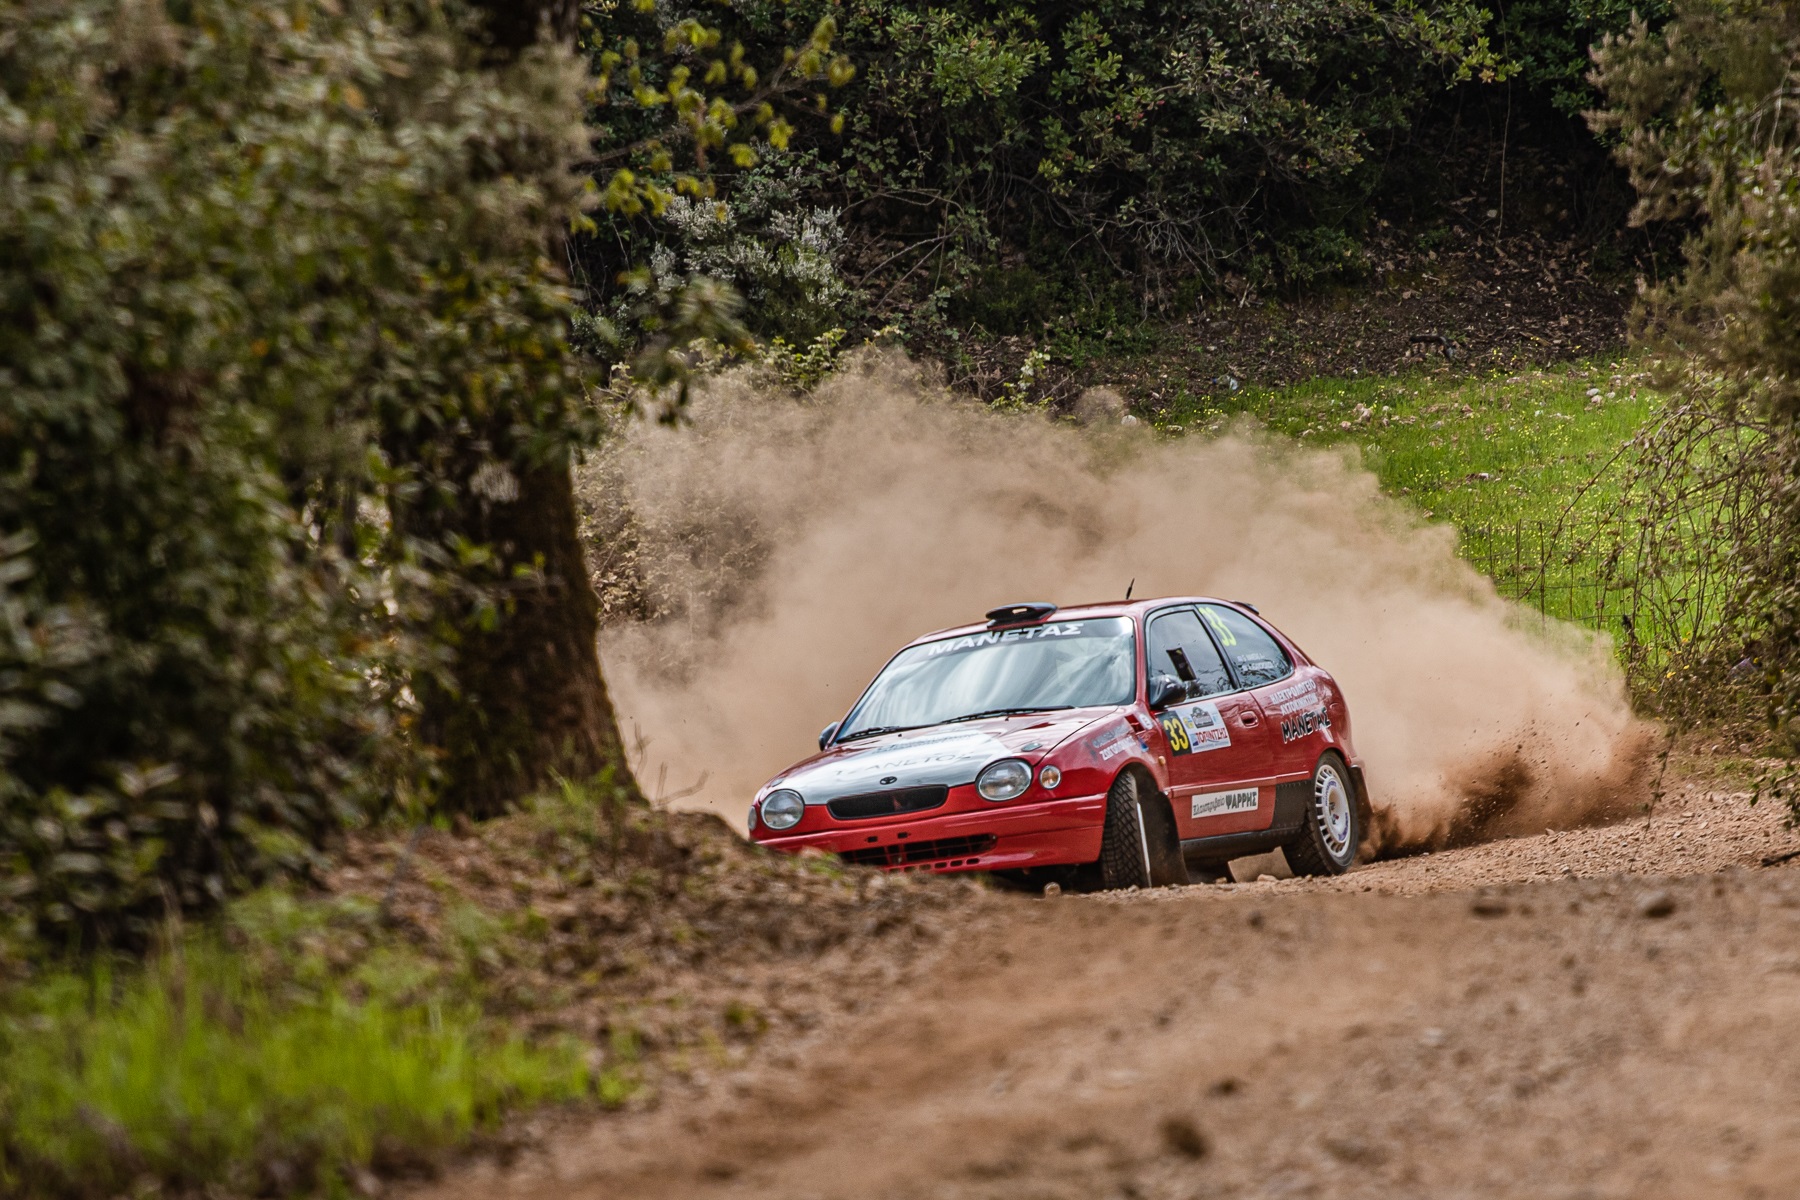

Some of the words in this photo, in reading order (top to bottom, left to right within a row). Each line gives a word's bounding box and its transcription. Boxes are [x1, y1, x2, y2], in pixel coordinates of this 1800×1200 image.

[928, 622, 1084, 656] ΜΑΝΕΤΑΣ
[1199, 606, 1236, 647] 33
[1163, 717, 1189, 751] 33
[1281, 706, 1332, 744] ΜΑΝΕΤΑΣ
[1225, 791, 1257, 810] ΨΑΡΡΗΣ
